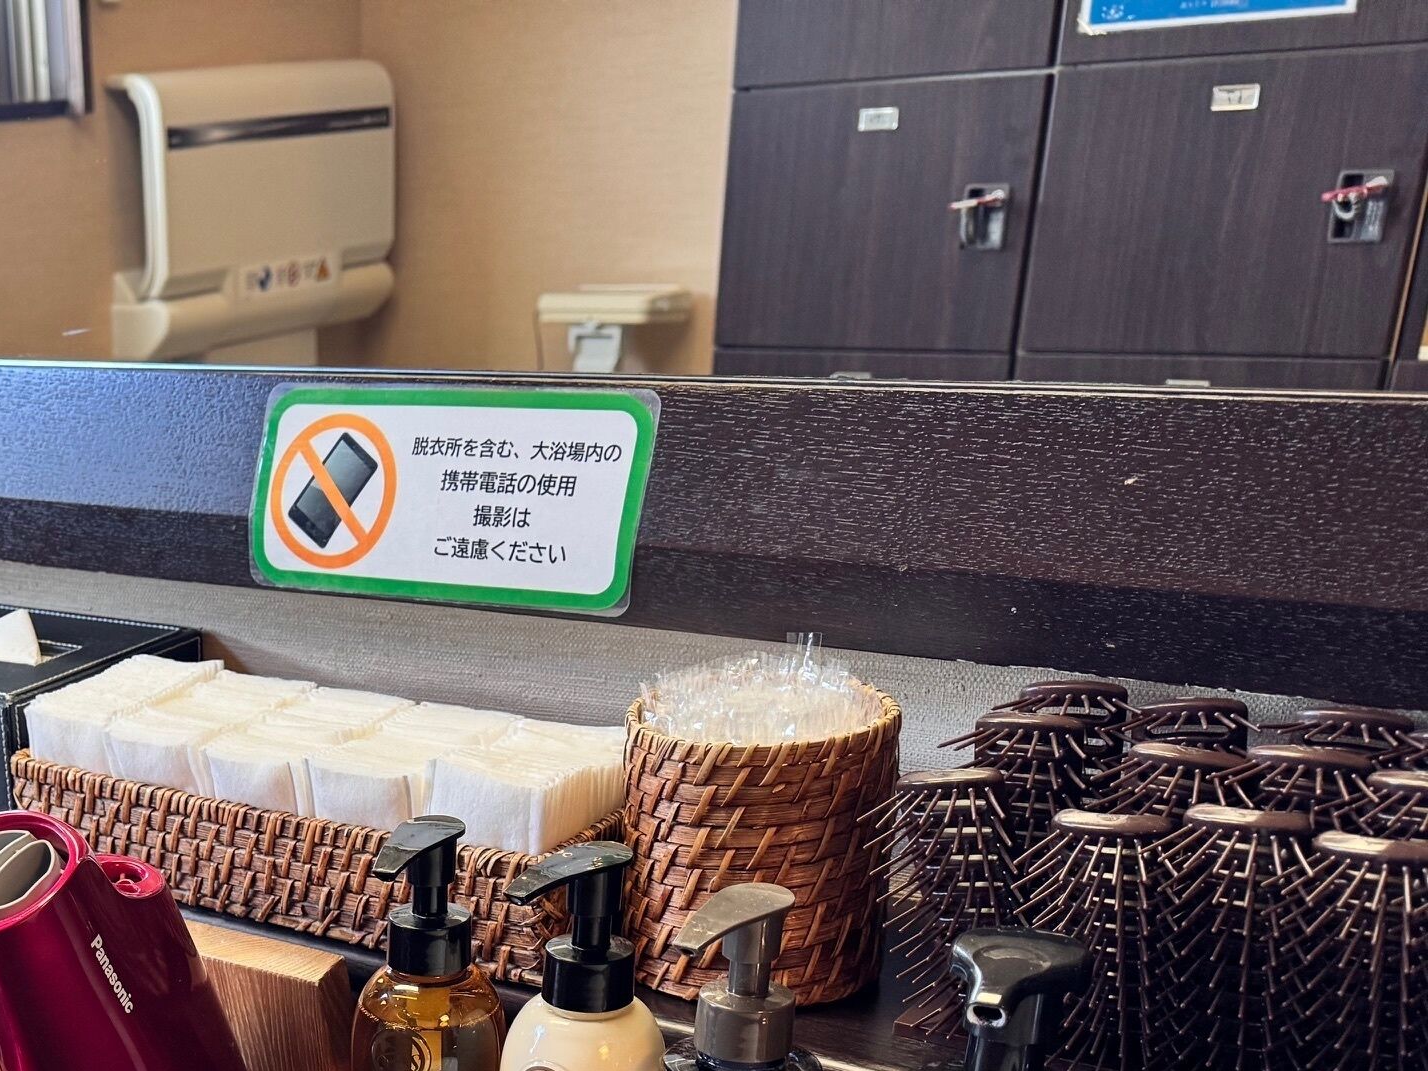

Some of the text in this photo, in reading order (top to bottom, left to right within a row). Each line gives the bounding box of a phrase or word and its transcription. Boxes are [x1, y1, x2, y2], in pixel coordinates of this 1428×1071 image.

[411, 436, 622, 463] 脱衣所を含む、大浴場内の
[440, 469, 578, 497] 携帯電話の使用
[472, 504, 532, 529] 撮影は
[433, 536, 567, 565] ご遠慮ください
[90, 933, 134, 1014] Panasonic
